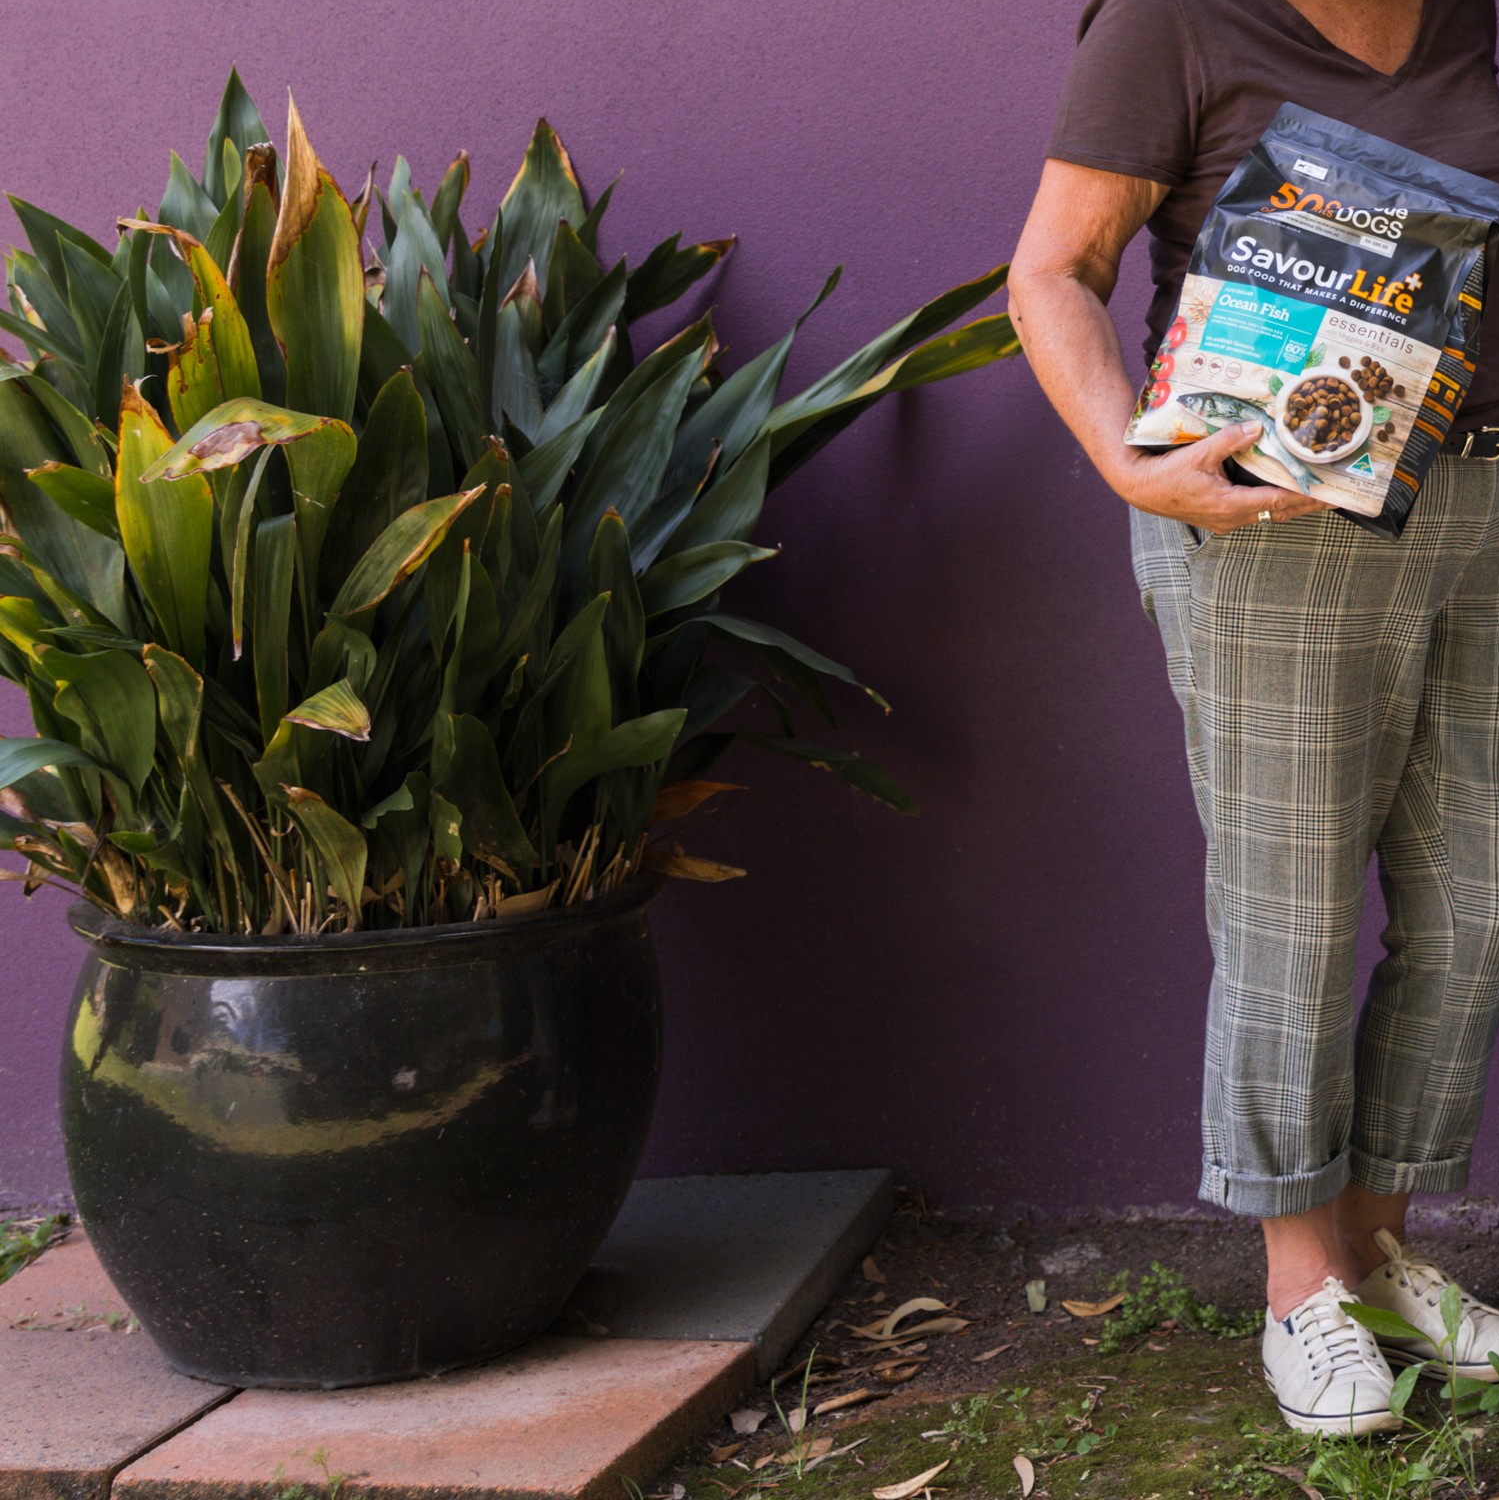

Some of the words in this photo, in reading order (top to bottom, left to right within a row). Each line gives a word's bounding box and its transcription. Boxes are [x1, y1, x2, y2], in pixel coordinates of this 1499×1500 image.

[1335, 208, 1403, 239] DOGS
[1218, 294, 1259, 313] Ocean
[1260, 302, 1290, 322] Fish
[1227, 264, 1246, 274] DOG
[1249, 268, 1276, 283] FOOD
[1279, 279, 1303, 292] THAT
[1304, 287, 1338, 300] MAKES
[1349, 299, 1408, 326] DIFFERENCE
[1285, 343, 1307, 357] 60%
[1329, 316, 1414, 354] essentials
